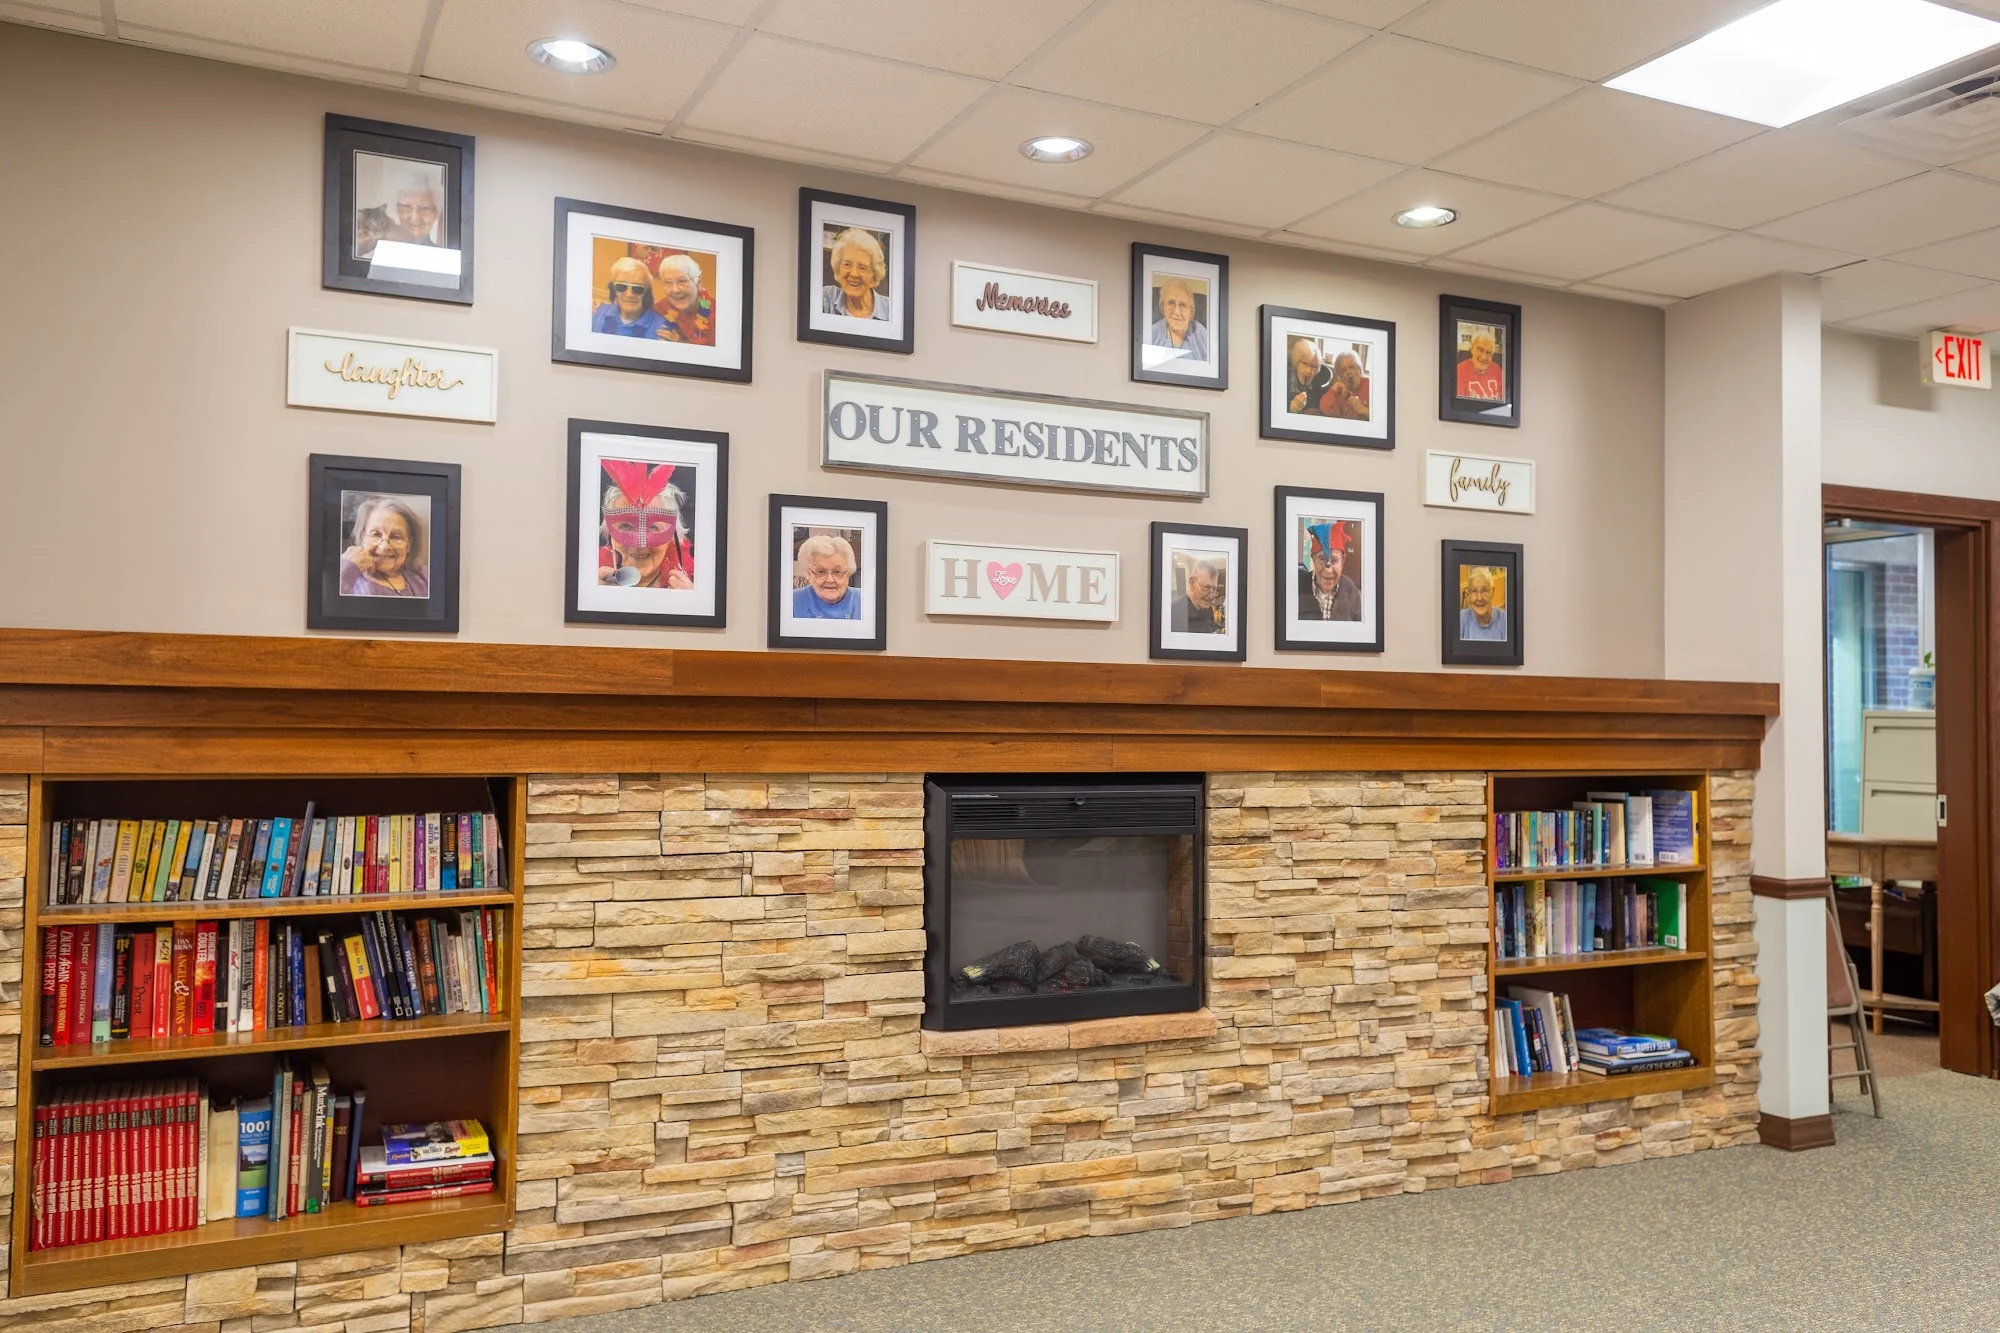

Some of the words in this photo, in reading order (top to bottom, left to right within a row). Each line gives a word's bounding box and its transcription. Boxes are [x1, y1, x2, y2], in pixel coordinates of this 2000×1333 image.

[976, 282, 1072, 318] Memories
[1944, 335, 1982, 381] EXIT
[324, 351, 464, 399] laughter
[829, 400, 942, 449] OUR
[954, 414, 1199, 473] RESIDENTS
[1449, 457, 1511, 506] family
[992, 570, 1018, 586] Love
[46, 933, 56, 959] ANNE
[81, 943, 91, 964] Jester
[159, 939, 170, 961] 1421
[197, 932, 207, 962] COULTER
[208, 932, 216, 961] CATHERINE
[44, 963, 55, 991] PERRY
[176, 954, 187, 982] ANGELS
[134, 987, 145, 1015] Priest
[176, 994, 185, 1024] DEMONS
[1636, 1042, 1656, 1052] RARELY
[1656, 1040, 1671, 1050] SEEN
[1631, 1064, 1646, 1073] ATLAS
[1647, 1063, 1655, 1071] OF
[1655, 1062, 1664, 1070] THE
[1664, 1060, 1683, 1069] WORLD
[316, 1086, 327, 1115] Murder
[241, 1121, 270, 1133] 1001
[315, 1116, 325, 1128] Ink
